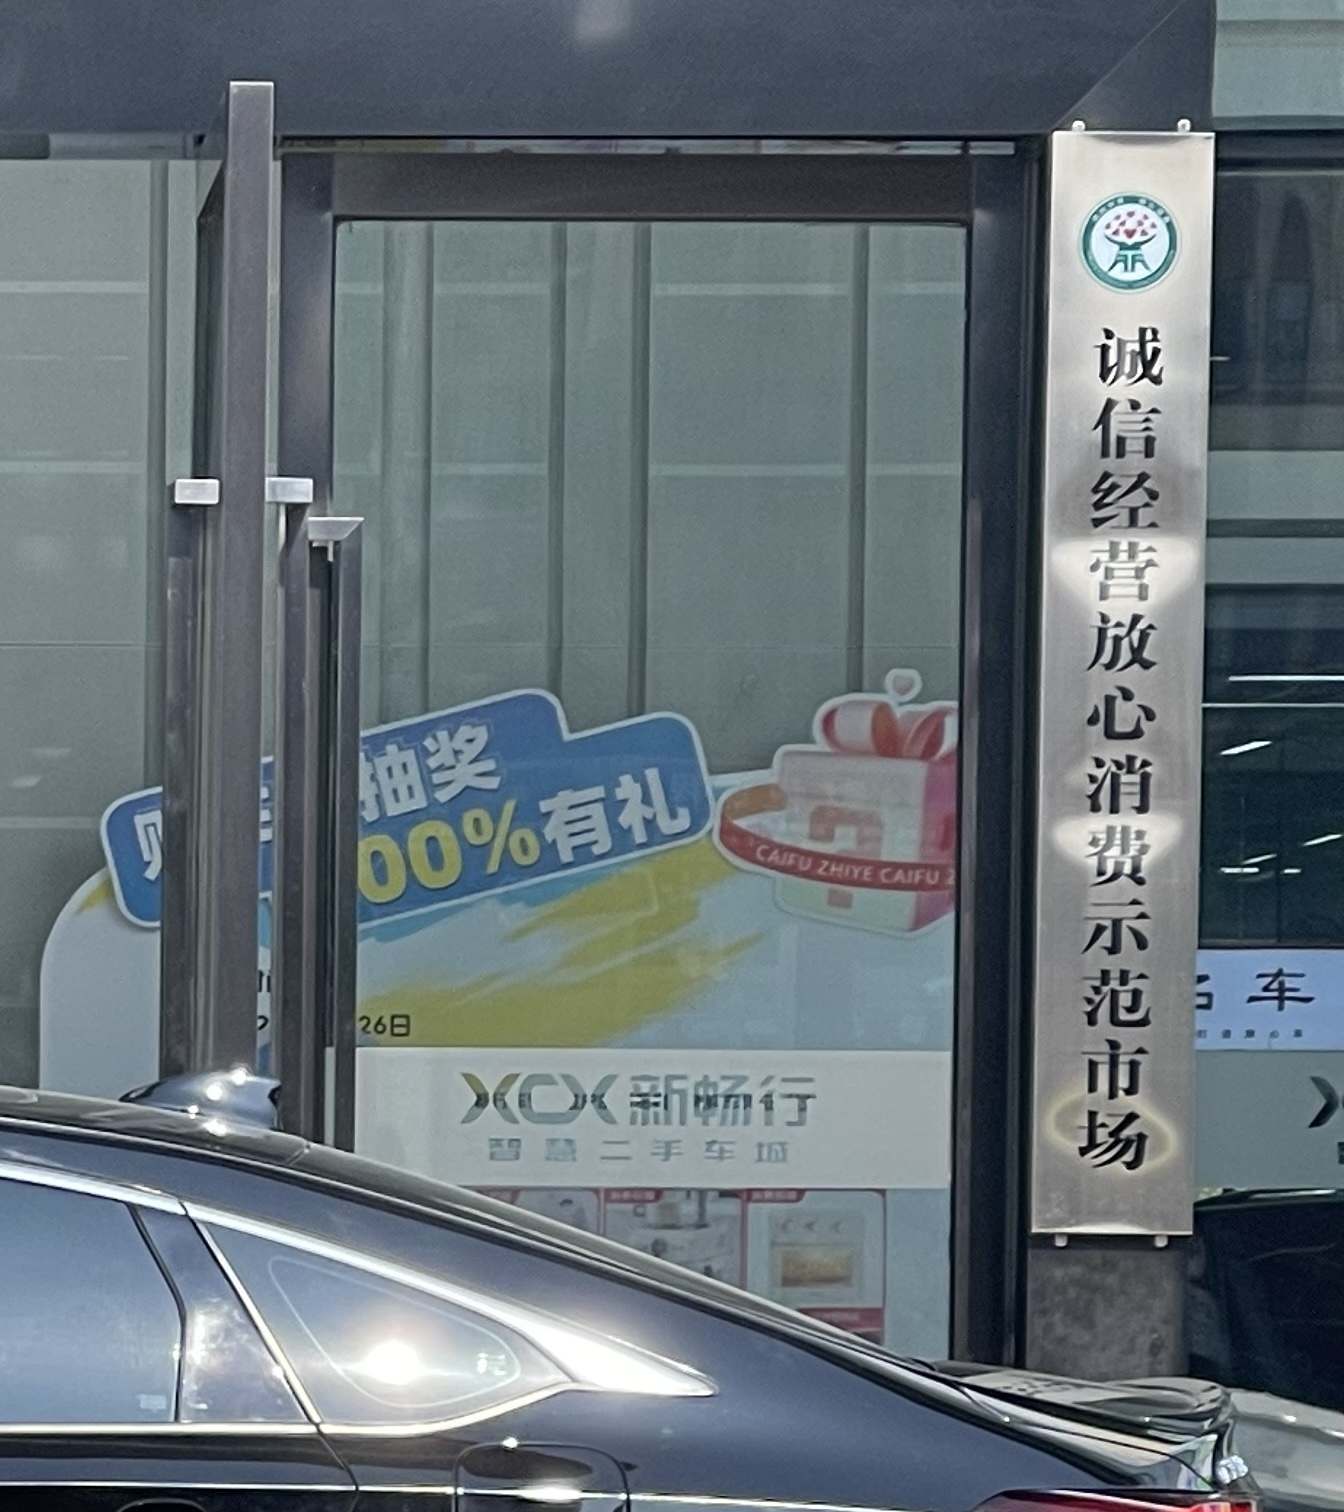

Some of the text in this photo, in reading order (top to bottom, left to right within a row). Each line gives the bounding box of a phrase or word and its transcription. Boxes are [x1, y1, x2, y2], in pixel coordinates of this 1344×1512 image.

[1078, 326, 1164, 1172] 诚信经营放心消费示范市场
[755, 844, 812, 871] CAIFU
[816, 859, 873, 882] ZHIYE
[878, 867, 940, 885] CAIFU
[629, 1074, 817, 1127] 新畅行
